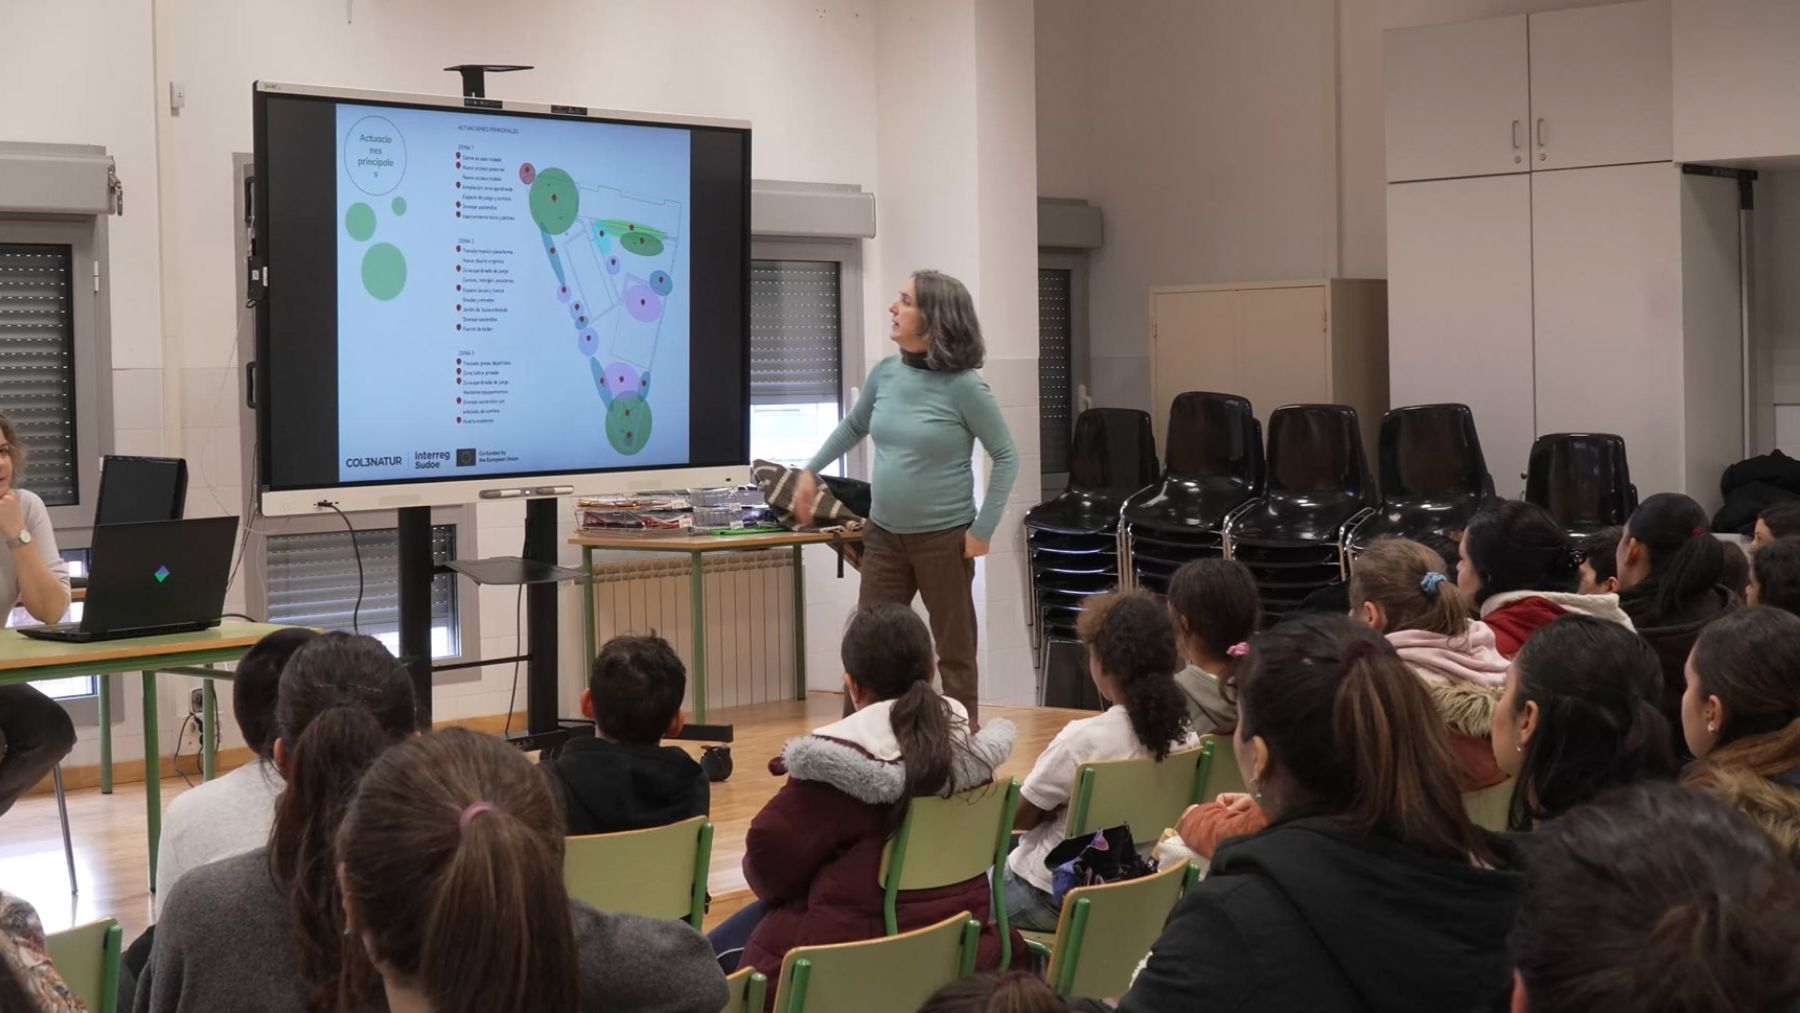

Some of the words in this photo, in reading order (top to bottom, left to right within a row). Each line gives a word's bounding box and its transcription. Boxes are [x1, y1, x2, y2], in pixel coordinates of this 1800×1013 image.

[360, 134, 392, 143] Actuacio
[358, 157, 394, 168] principale
[414, 451, 450, 460] Interreg
[345, 456, 402, 468] COL3NATUR
[415, 461, 440, 469] Sudoe
